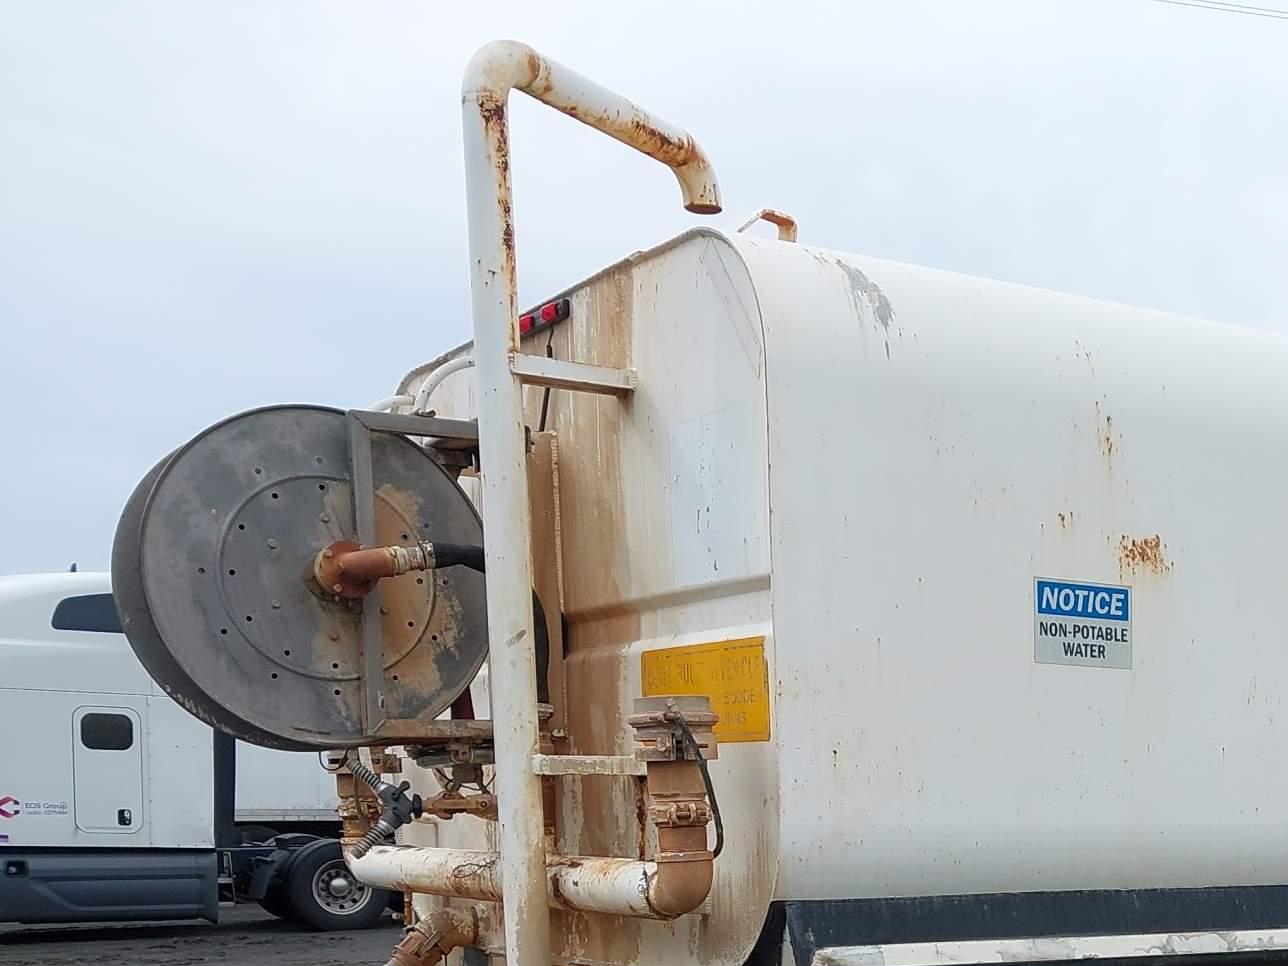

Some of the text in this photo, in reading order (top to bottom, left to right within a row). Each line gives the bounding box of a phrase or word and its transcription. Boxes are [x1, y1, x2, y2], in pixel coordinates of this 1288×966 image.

[1041, 587, 1124, 616] NOTICE
[1039, 621, 1129, 643] NON-POTABLE
[1062, 641, 1106, 659] WATER
